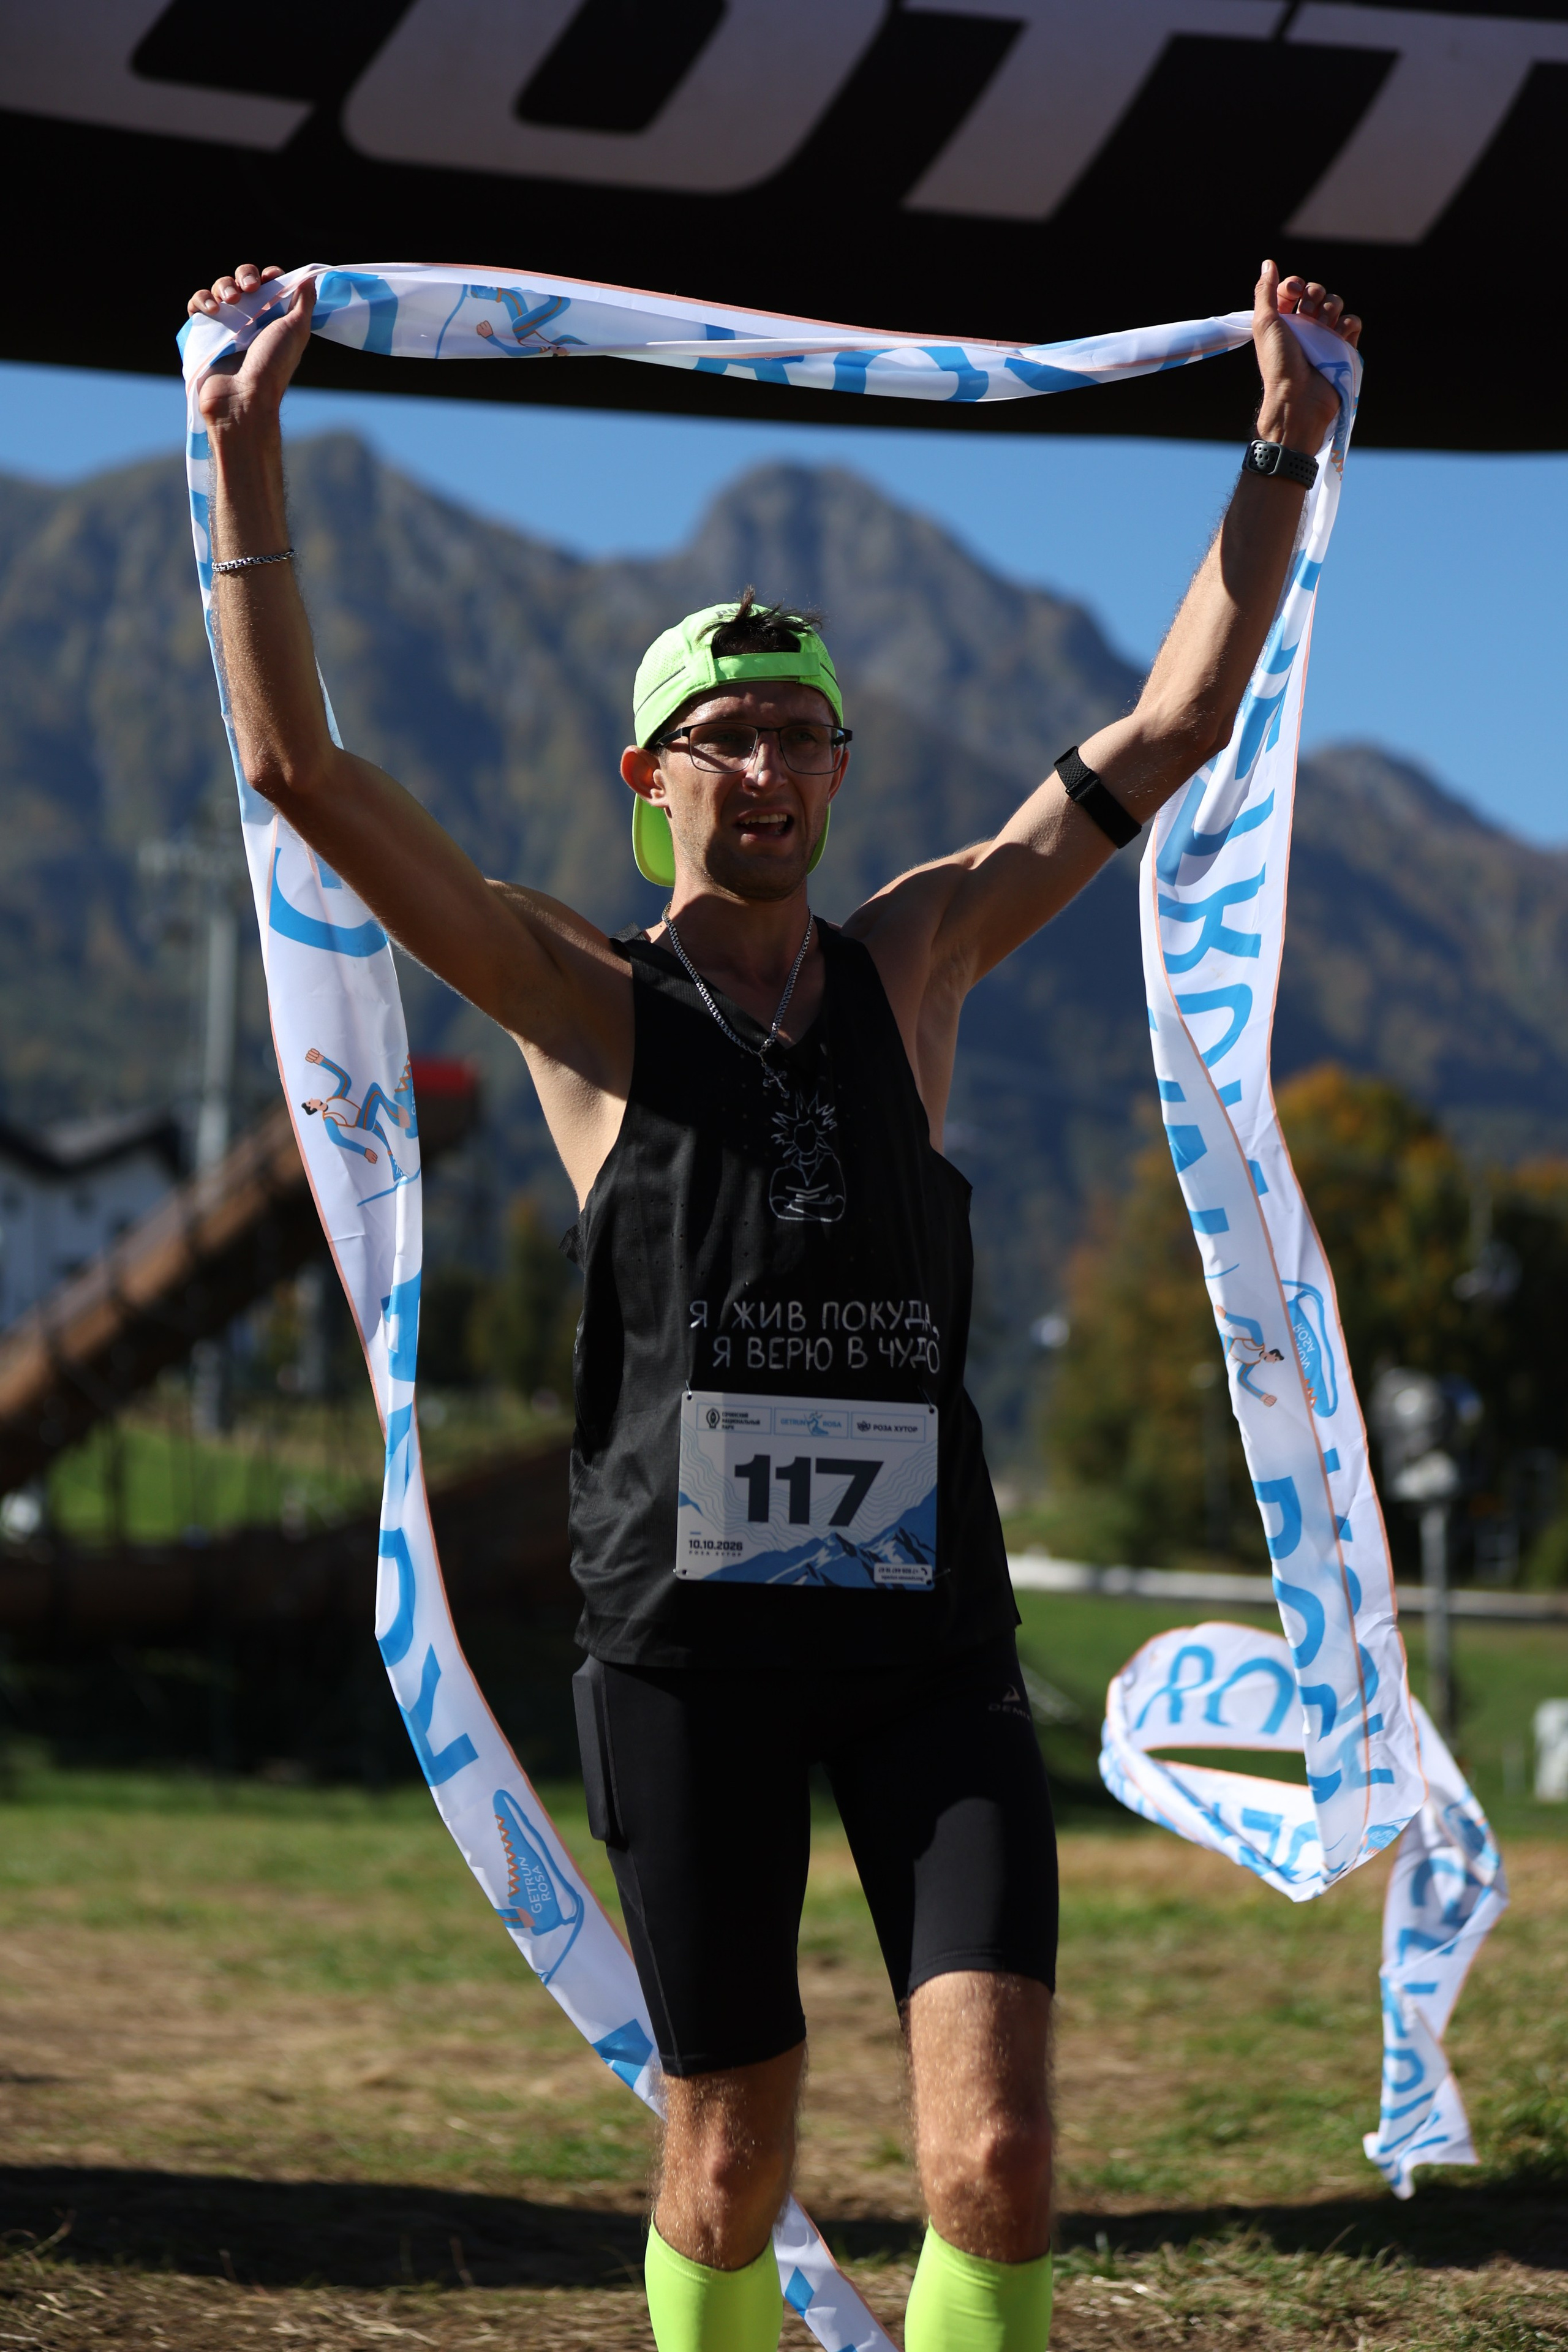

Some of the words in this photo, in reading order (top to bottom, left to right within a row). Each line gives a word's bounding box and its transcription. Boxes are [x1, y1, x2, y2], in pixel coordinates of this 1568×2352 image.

[689, 1300, 709, 1328] Я
[731, 1300, 807, 1331] ЖИВ
[712, 1336, 732, 1368] Я
[747, 1336, 833, 1371] ВЕРЮ
[848, 1337, 869, 1368] В
[878, 1337, 940, 1374] ЧУДО
[735, 1454, 884, 1527] 117
[518, 1857, 542, 1913] GETRUN
[532, 1866, 551, 1901] ROSA
